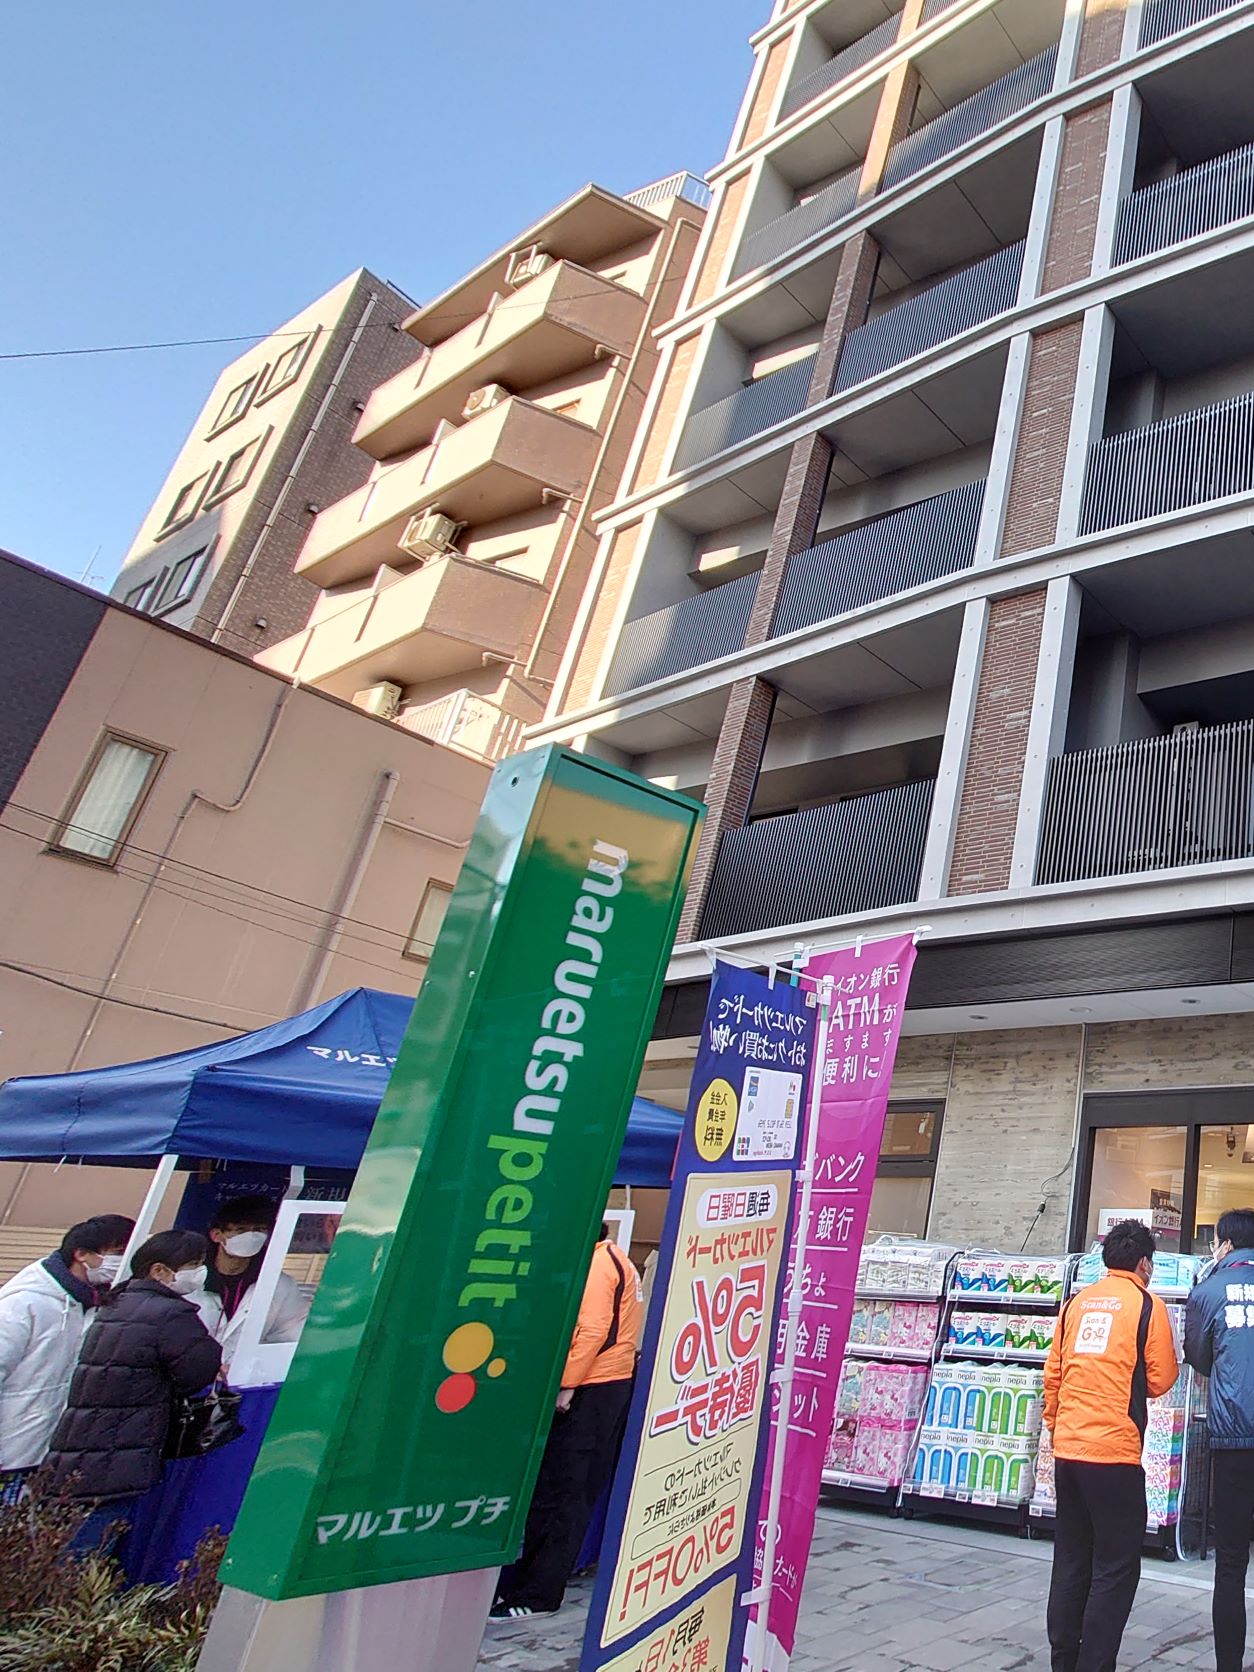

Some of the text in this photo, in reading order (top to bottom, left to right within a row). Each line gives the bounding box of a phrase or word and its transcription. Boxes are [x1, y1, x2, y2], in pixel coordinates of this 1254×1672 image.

[317, 1495, 511, 1545] マルエツ プチ
